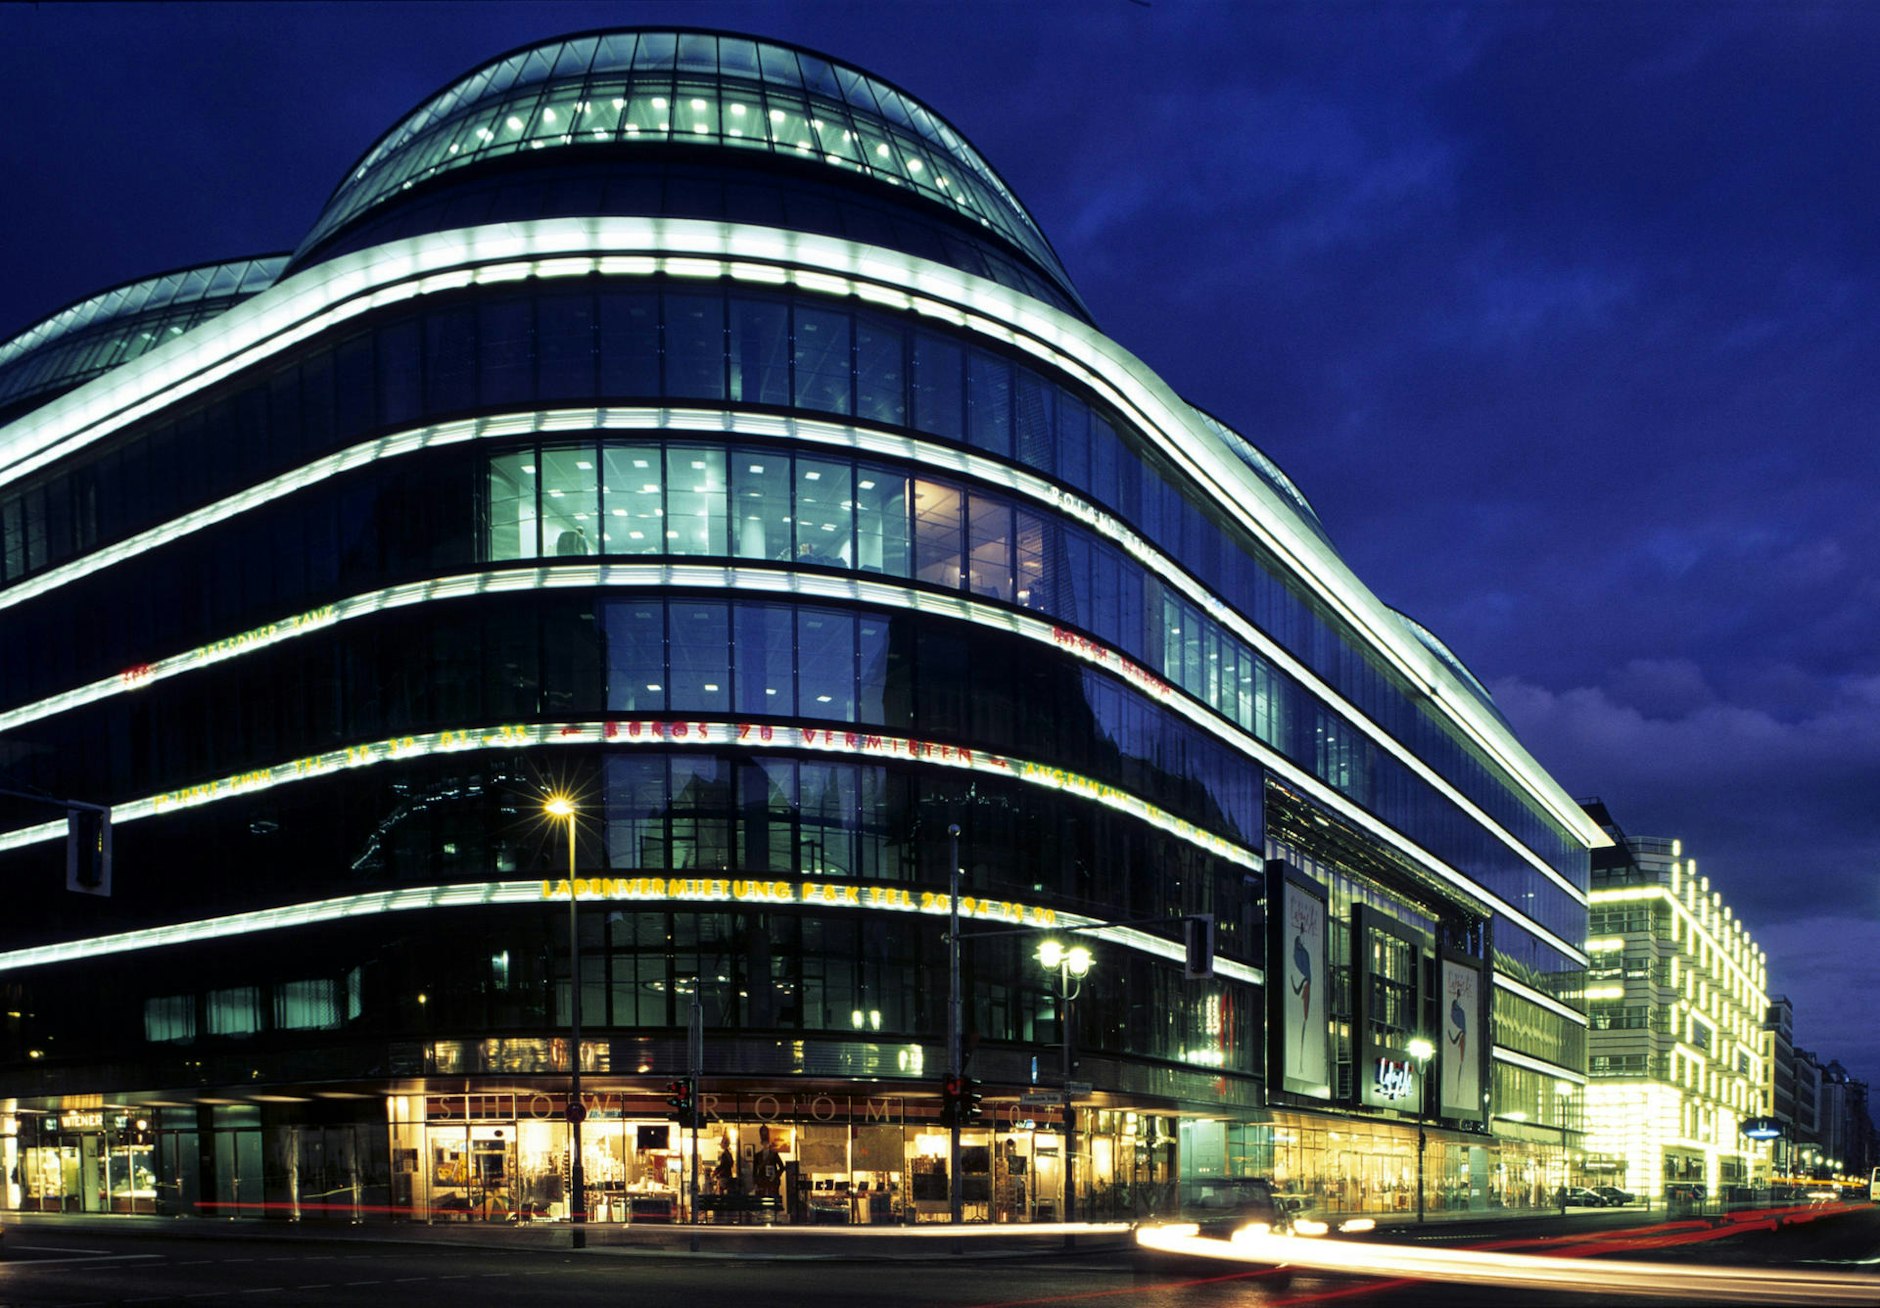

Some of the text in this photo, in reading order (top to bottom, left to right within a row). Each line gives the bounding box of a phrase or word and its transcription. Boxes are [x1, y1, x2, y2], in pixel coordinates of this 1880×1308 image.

[737, 723, 773, 741] ZU
[802, 728, 973, 763] VERMIETEN
[542, 877, 791, 898] LADENVERMIETUNG
[802, 882, 816, 900] P
[846, 886, 859, 904] K
[61, 1114, 103, 1128] WIENER
[439, 1094, 611, 1120] SHOW
[702, 1095, 890, 1122] ROOM
[1758, 1121, 1768, 1131] U
